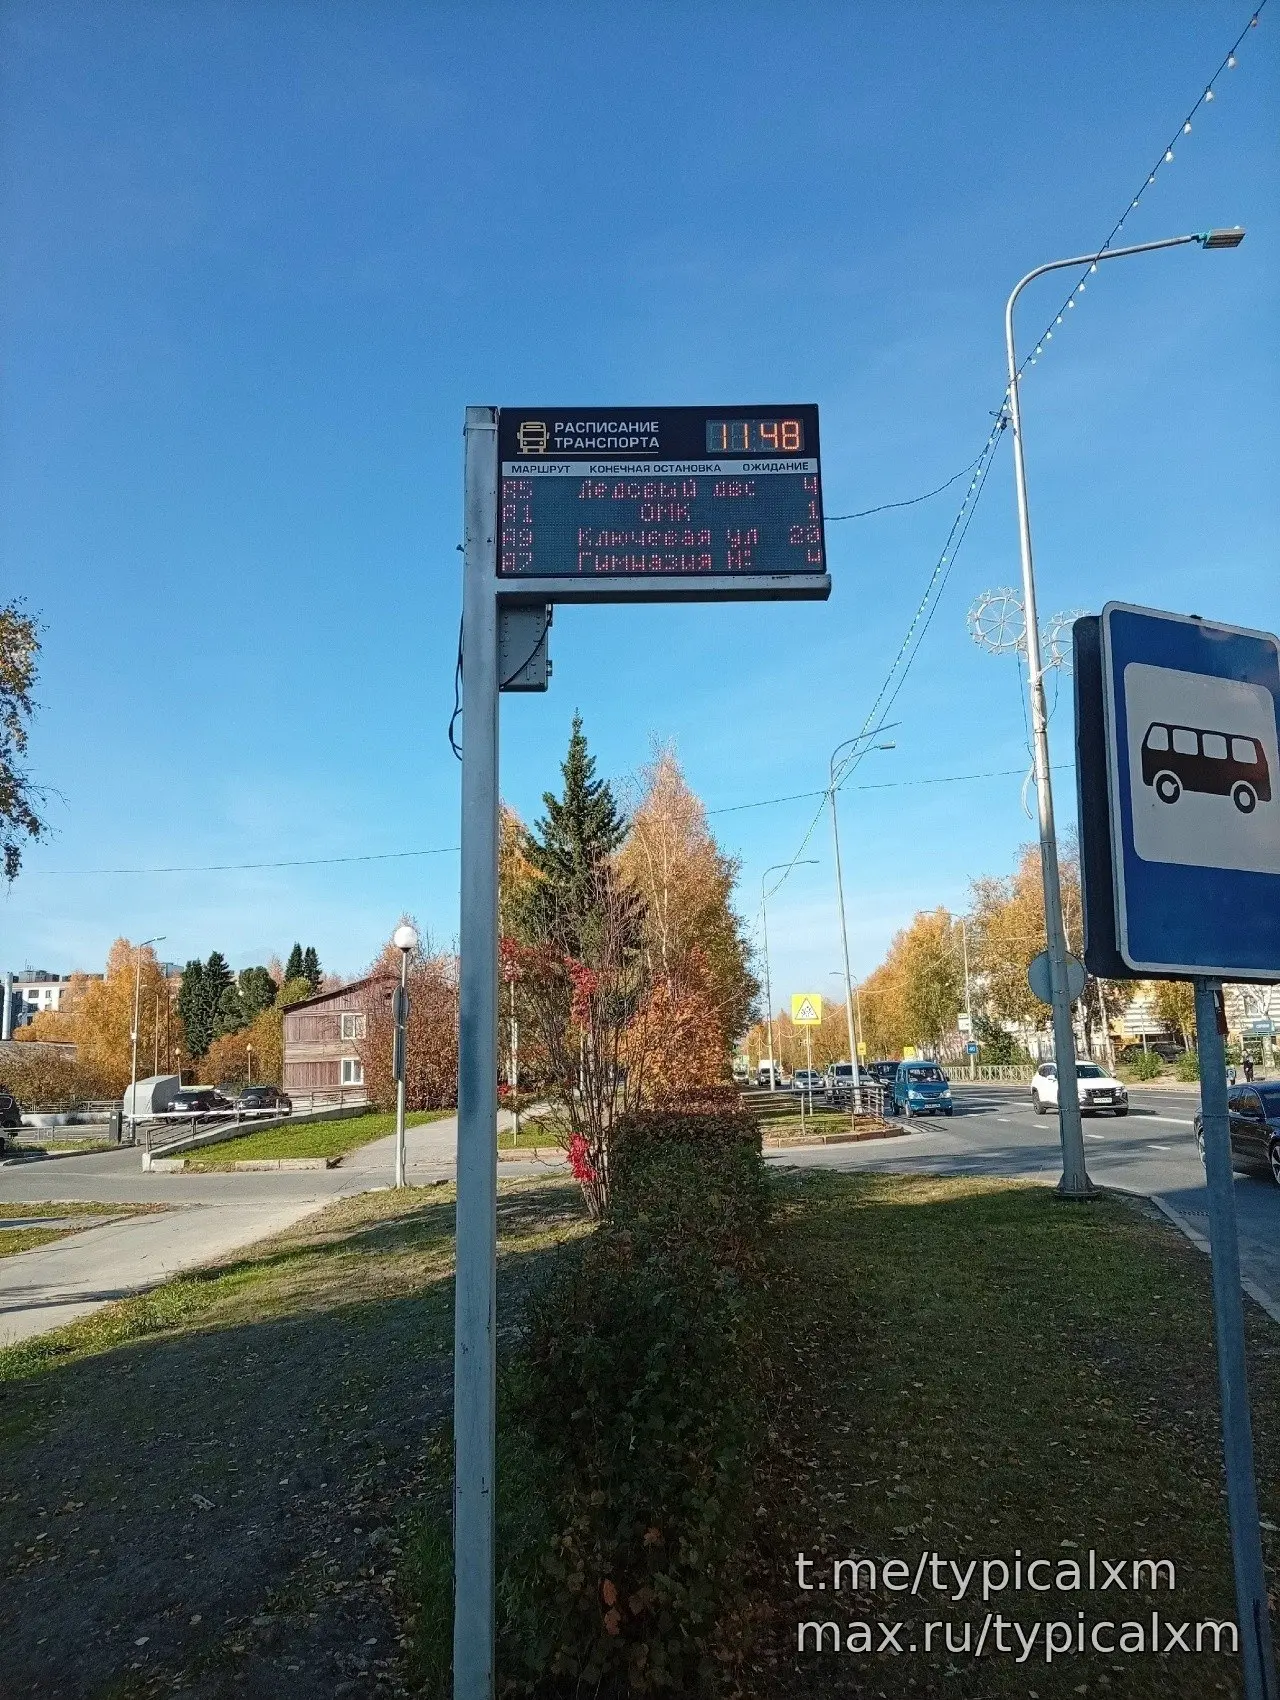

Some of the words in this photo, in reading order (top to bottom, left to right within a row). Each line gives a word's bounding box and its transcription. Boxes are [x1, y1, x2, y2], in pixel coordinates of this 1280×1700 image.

[554, 421, 660, 434] РАСПИСАНИЕ
[554, 437, 660, 449] ТРАНСПОРТА
[511, 465, 571, 474] МАРШРУТ
[589, 464, 651, 474] КОНЕЧНАЯ
[653, 463, 722, 473] ОСТАНОВКА
[742, 462, 809, 473] ОЖИДАНИЕ
[808, 501, 820, 520] 1
